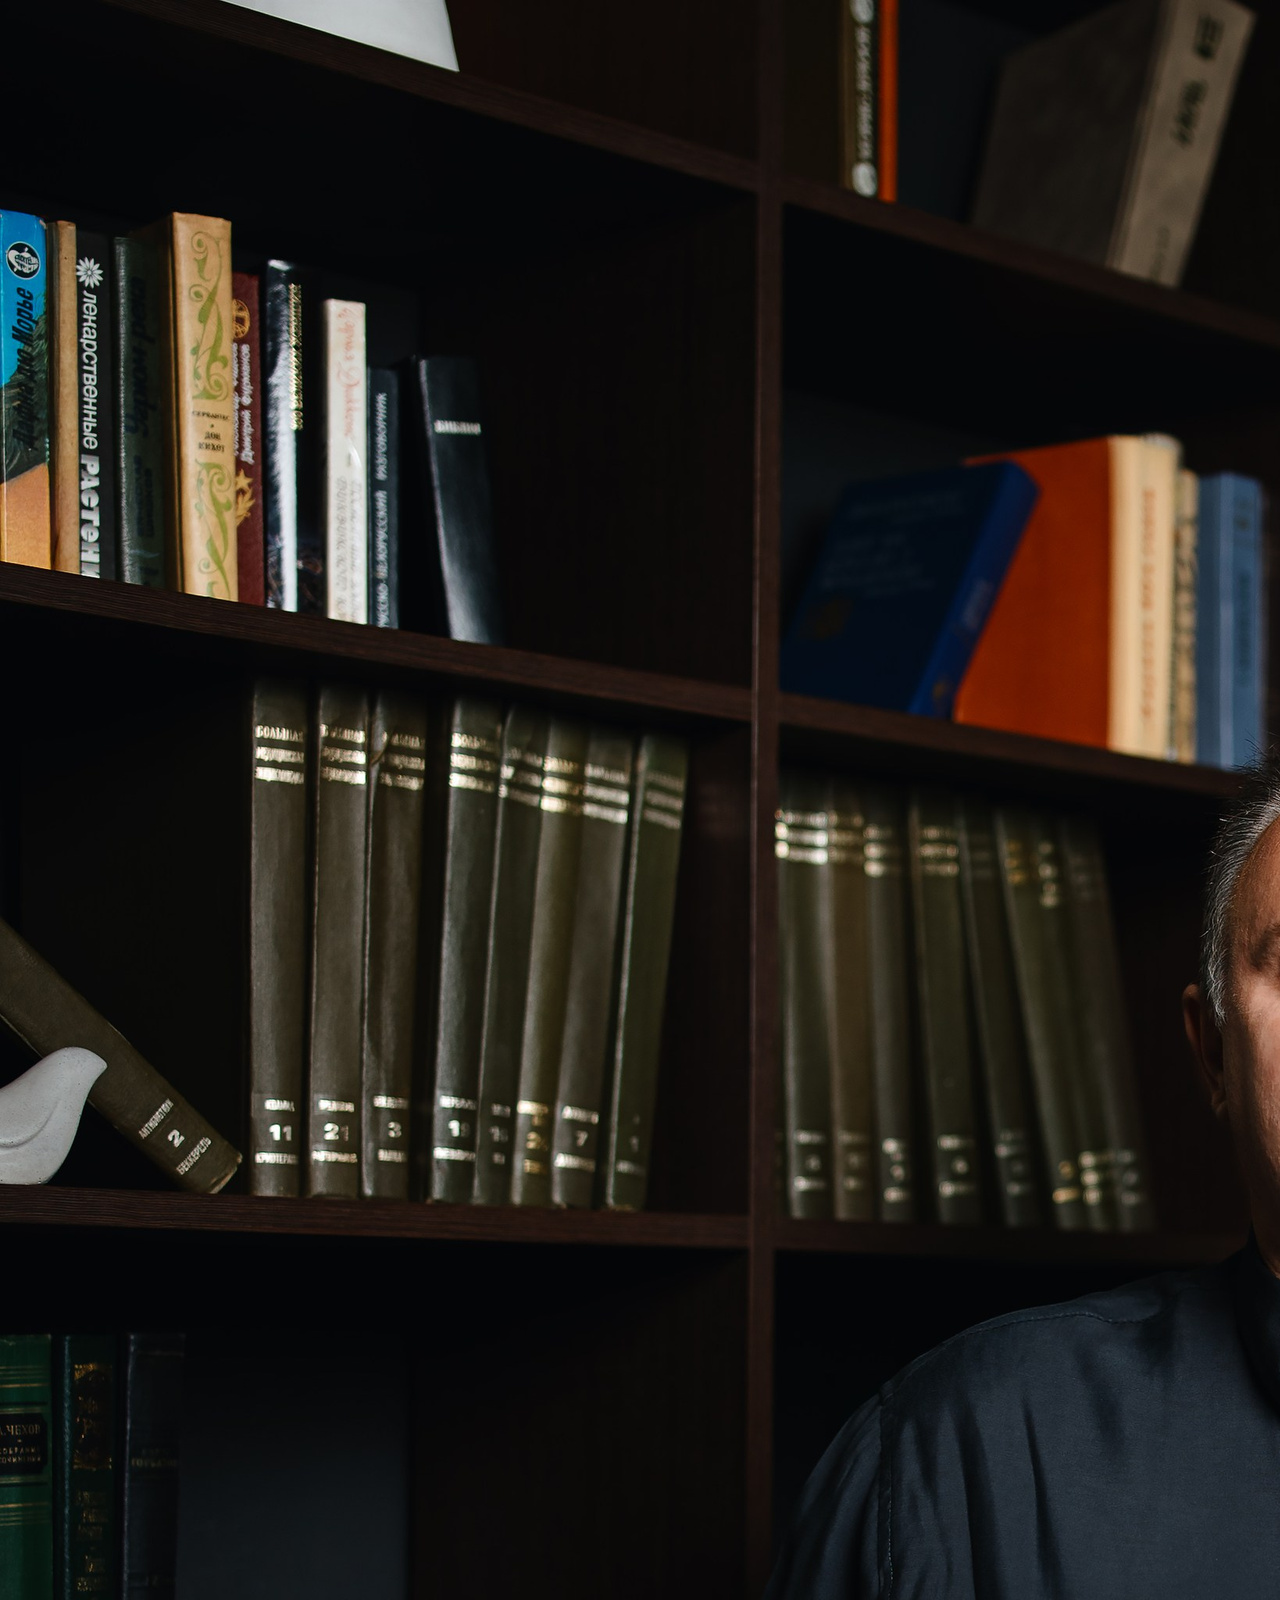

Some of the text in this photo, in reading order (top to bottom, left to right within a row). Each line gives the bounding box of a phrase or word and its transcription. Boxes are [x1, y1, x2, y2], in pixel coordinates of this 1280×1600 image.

[12, 286, 34, 347] Морье
[80, 290, 100, 450] лекарственные
[204, 431, 221, 440] ДОН
[198, 442, 225, 453] КИХОТ
[268, 1124, 292, 1141] 11
[323, 1122, 349, 1141] 21
[388, 1121, 402, 1138] 3
[167, 1129, 185, 1148] 2
[575, 1130, 589, 1147] 7
